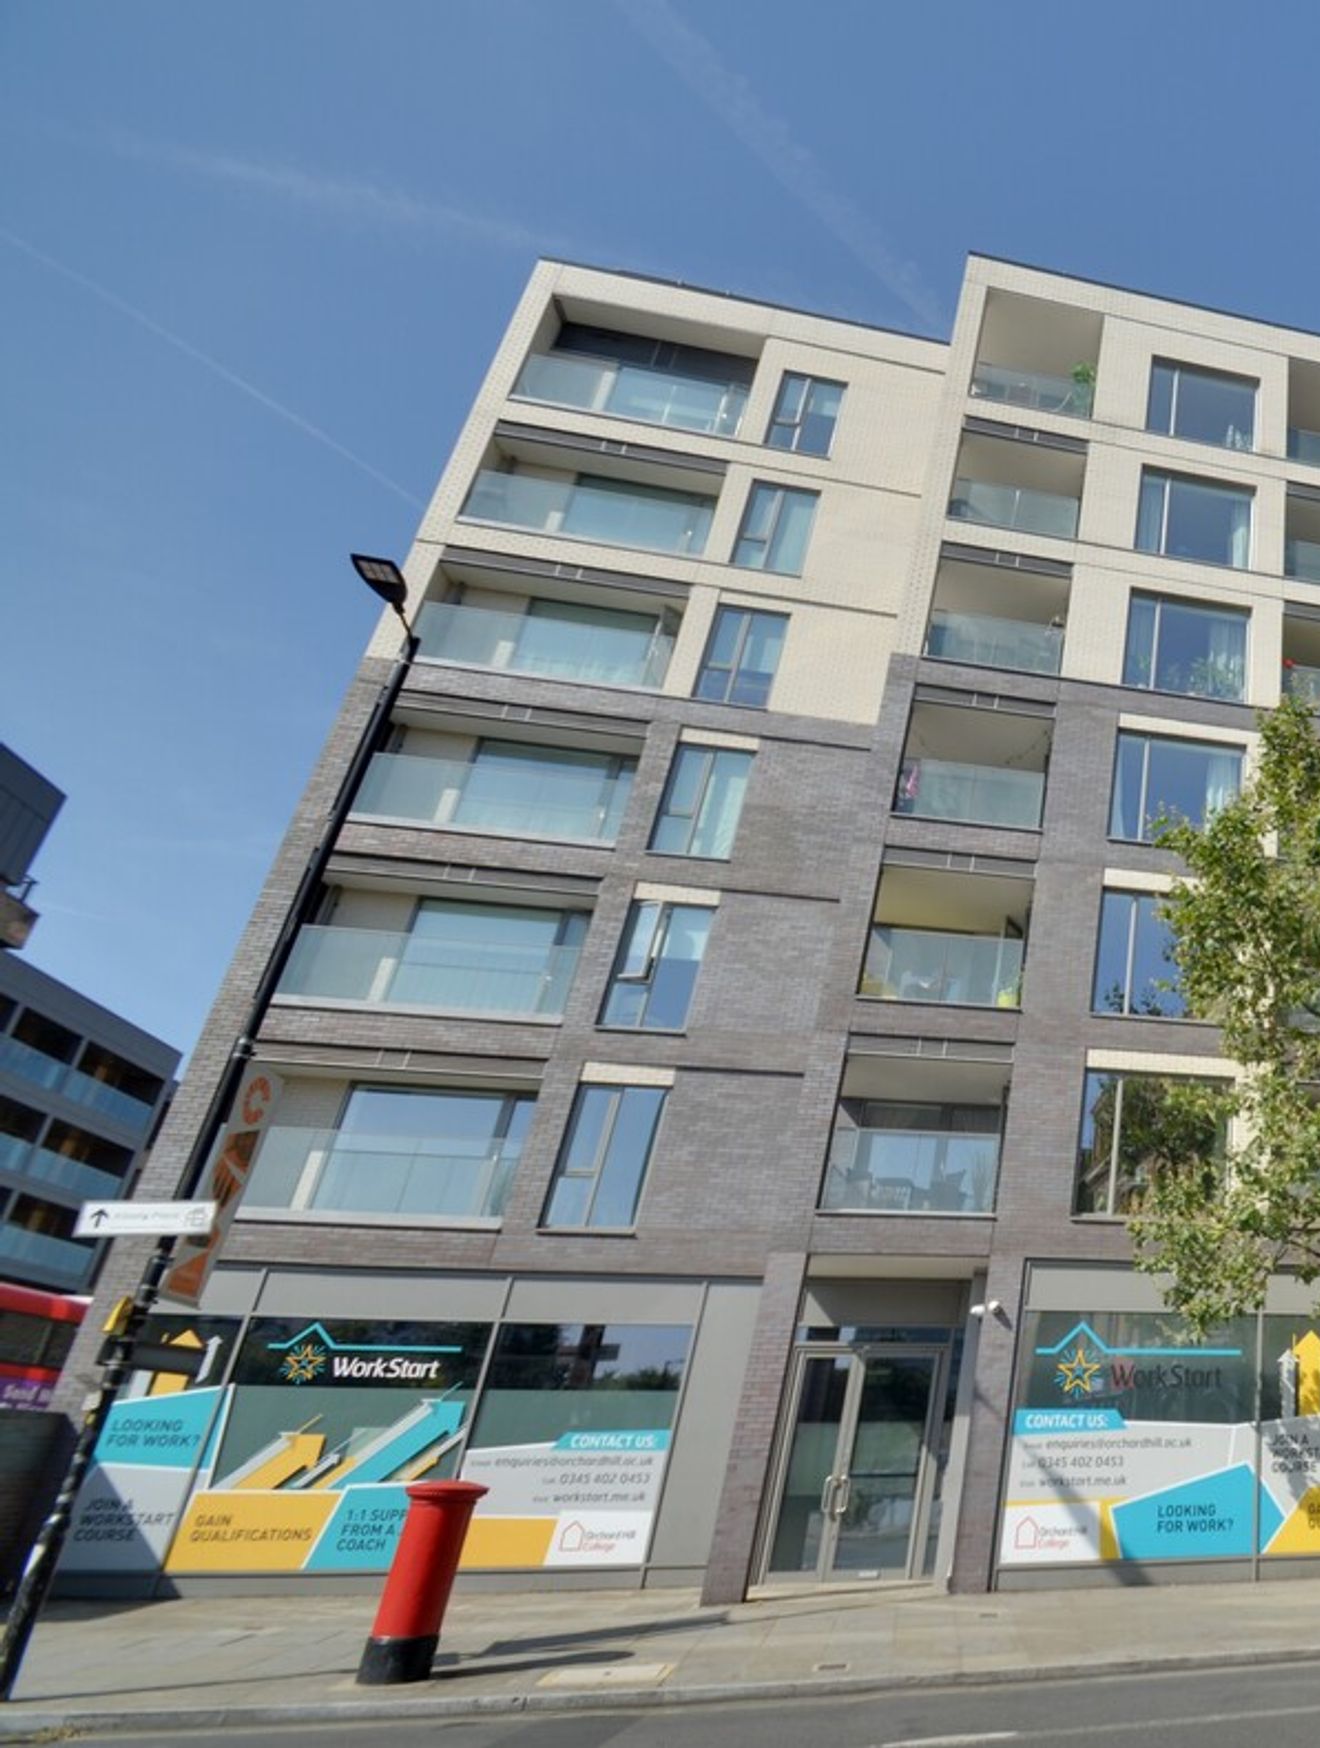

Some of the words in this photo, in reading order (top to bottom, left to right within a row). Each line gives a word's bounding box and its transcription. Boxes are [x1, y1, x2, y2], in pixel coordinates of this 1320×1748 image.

[333, 1357, 440, 1378] WorkStart
[1110, 1364, 1221, 1388] WorkStart
[112, 1419, 183, 1431] LOOKING
[1025, 1414, 1085, 1429] CONTACT
[1087, 1414, 1109, 1428] US:
[106, 1434, 139, 1447] FOR
[143, 1434, 199, 1447] WORK?
[570, 1434, 633, 1448] CONTACT
[1070, 1456, 1093, 1467] 402
[1095, 1455, 1124, 1467] 0453
[594, 1473, 617, 1484] 402
[86, 1499, 121, 1511] JOIN
[1157, 1504, 1217, 1518] LOOKING
[80, 1513, 176, 1526] WORKSTART
[195, 1514, 233, 1527] GAIN
[347, 1509, 367, 1521] 1:1
[340, 1524, 383, 1536] FROM
[385, 1524, 395, 1536] A
[1157, 1520, 1183, 1533] FOR
[1186, 1518, 1234, 1532] WORK?
[73, 1529, 137, 1542] COURSE
[189, 1528, 312, 1543] QUALIFICATIONS
[336, 1539, 387, 1551] COACH
